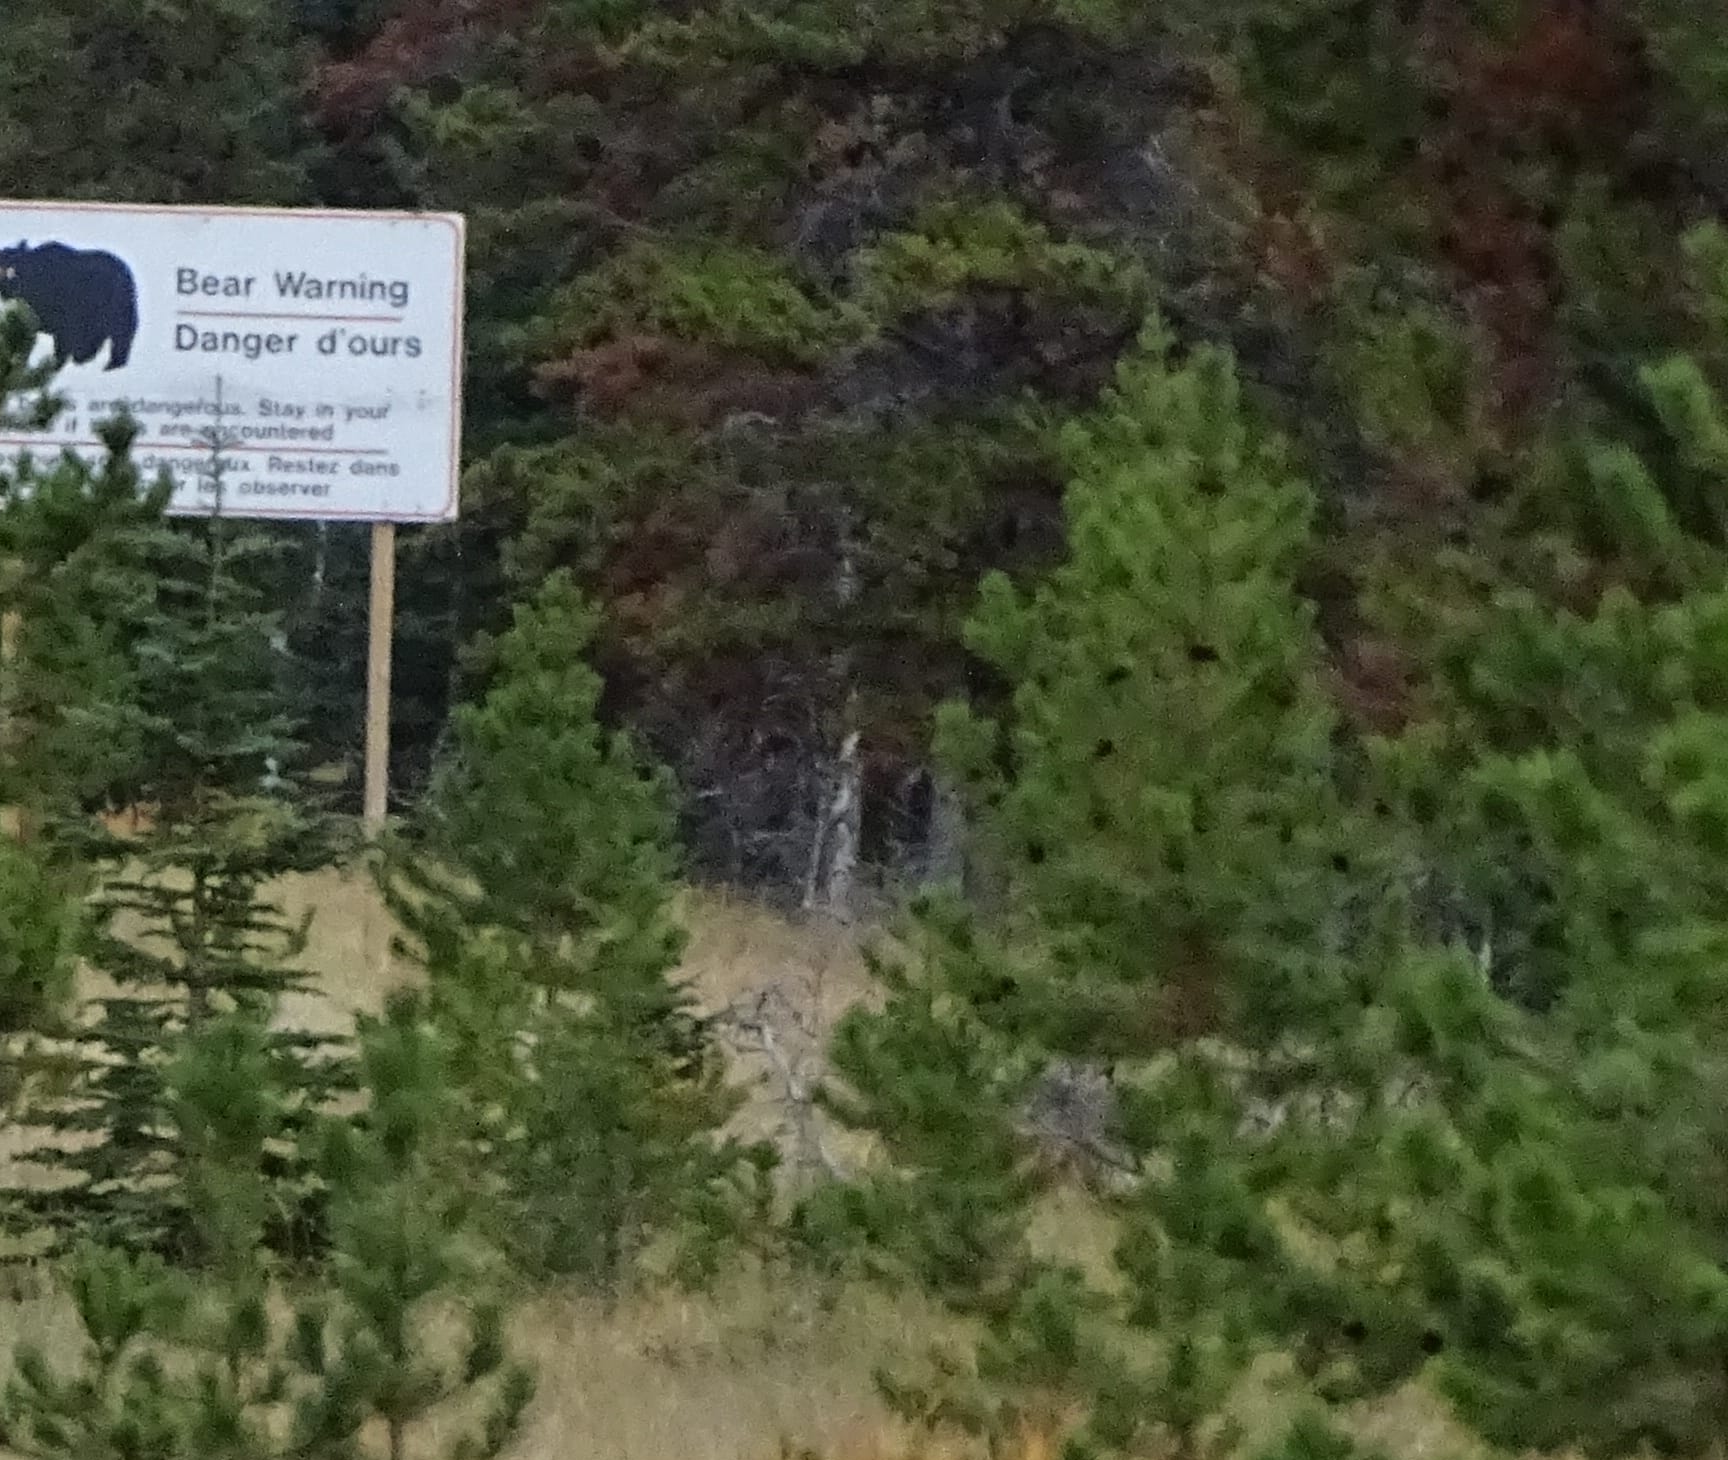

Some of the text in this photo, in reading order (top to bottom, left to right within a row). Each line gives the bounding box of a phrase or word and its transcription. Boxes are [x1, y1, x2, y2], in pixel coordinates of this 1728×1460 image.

[176, 267, 410, 308] Bear Warning
[175, 323, 423, 360] Danger d'ours
[257, 398, 305, 420] Stay
[315, 401, 335, 418] in
[267, 454, 339, 474] Restez
[348, 459, 401, 477] dans
[239, 479, 331, 497] observer
